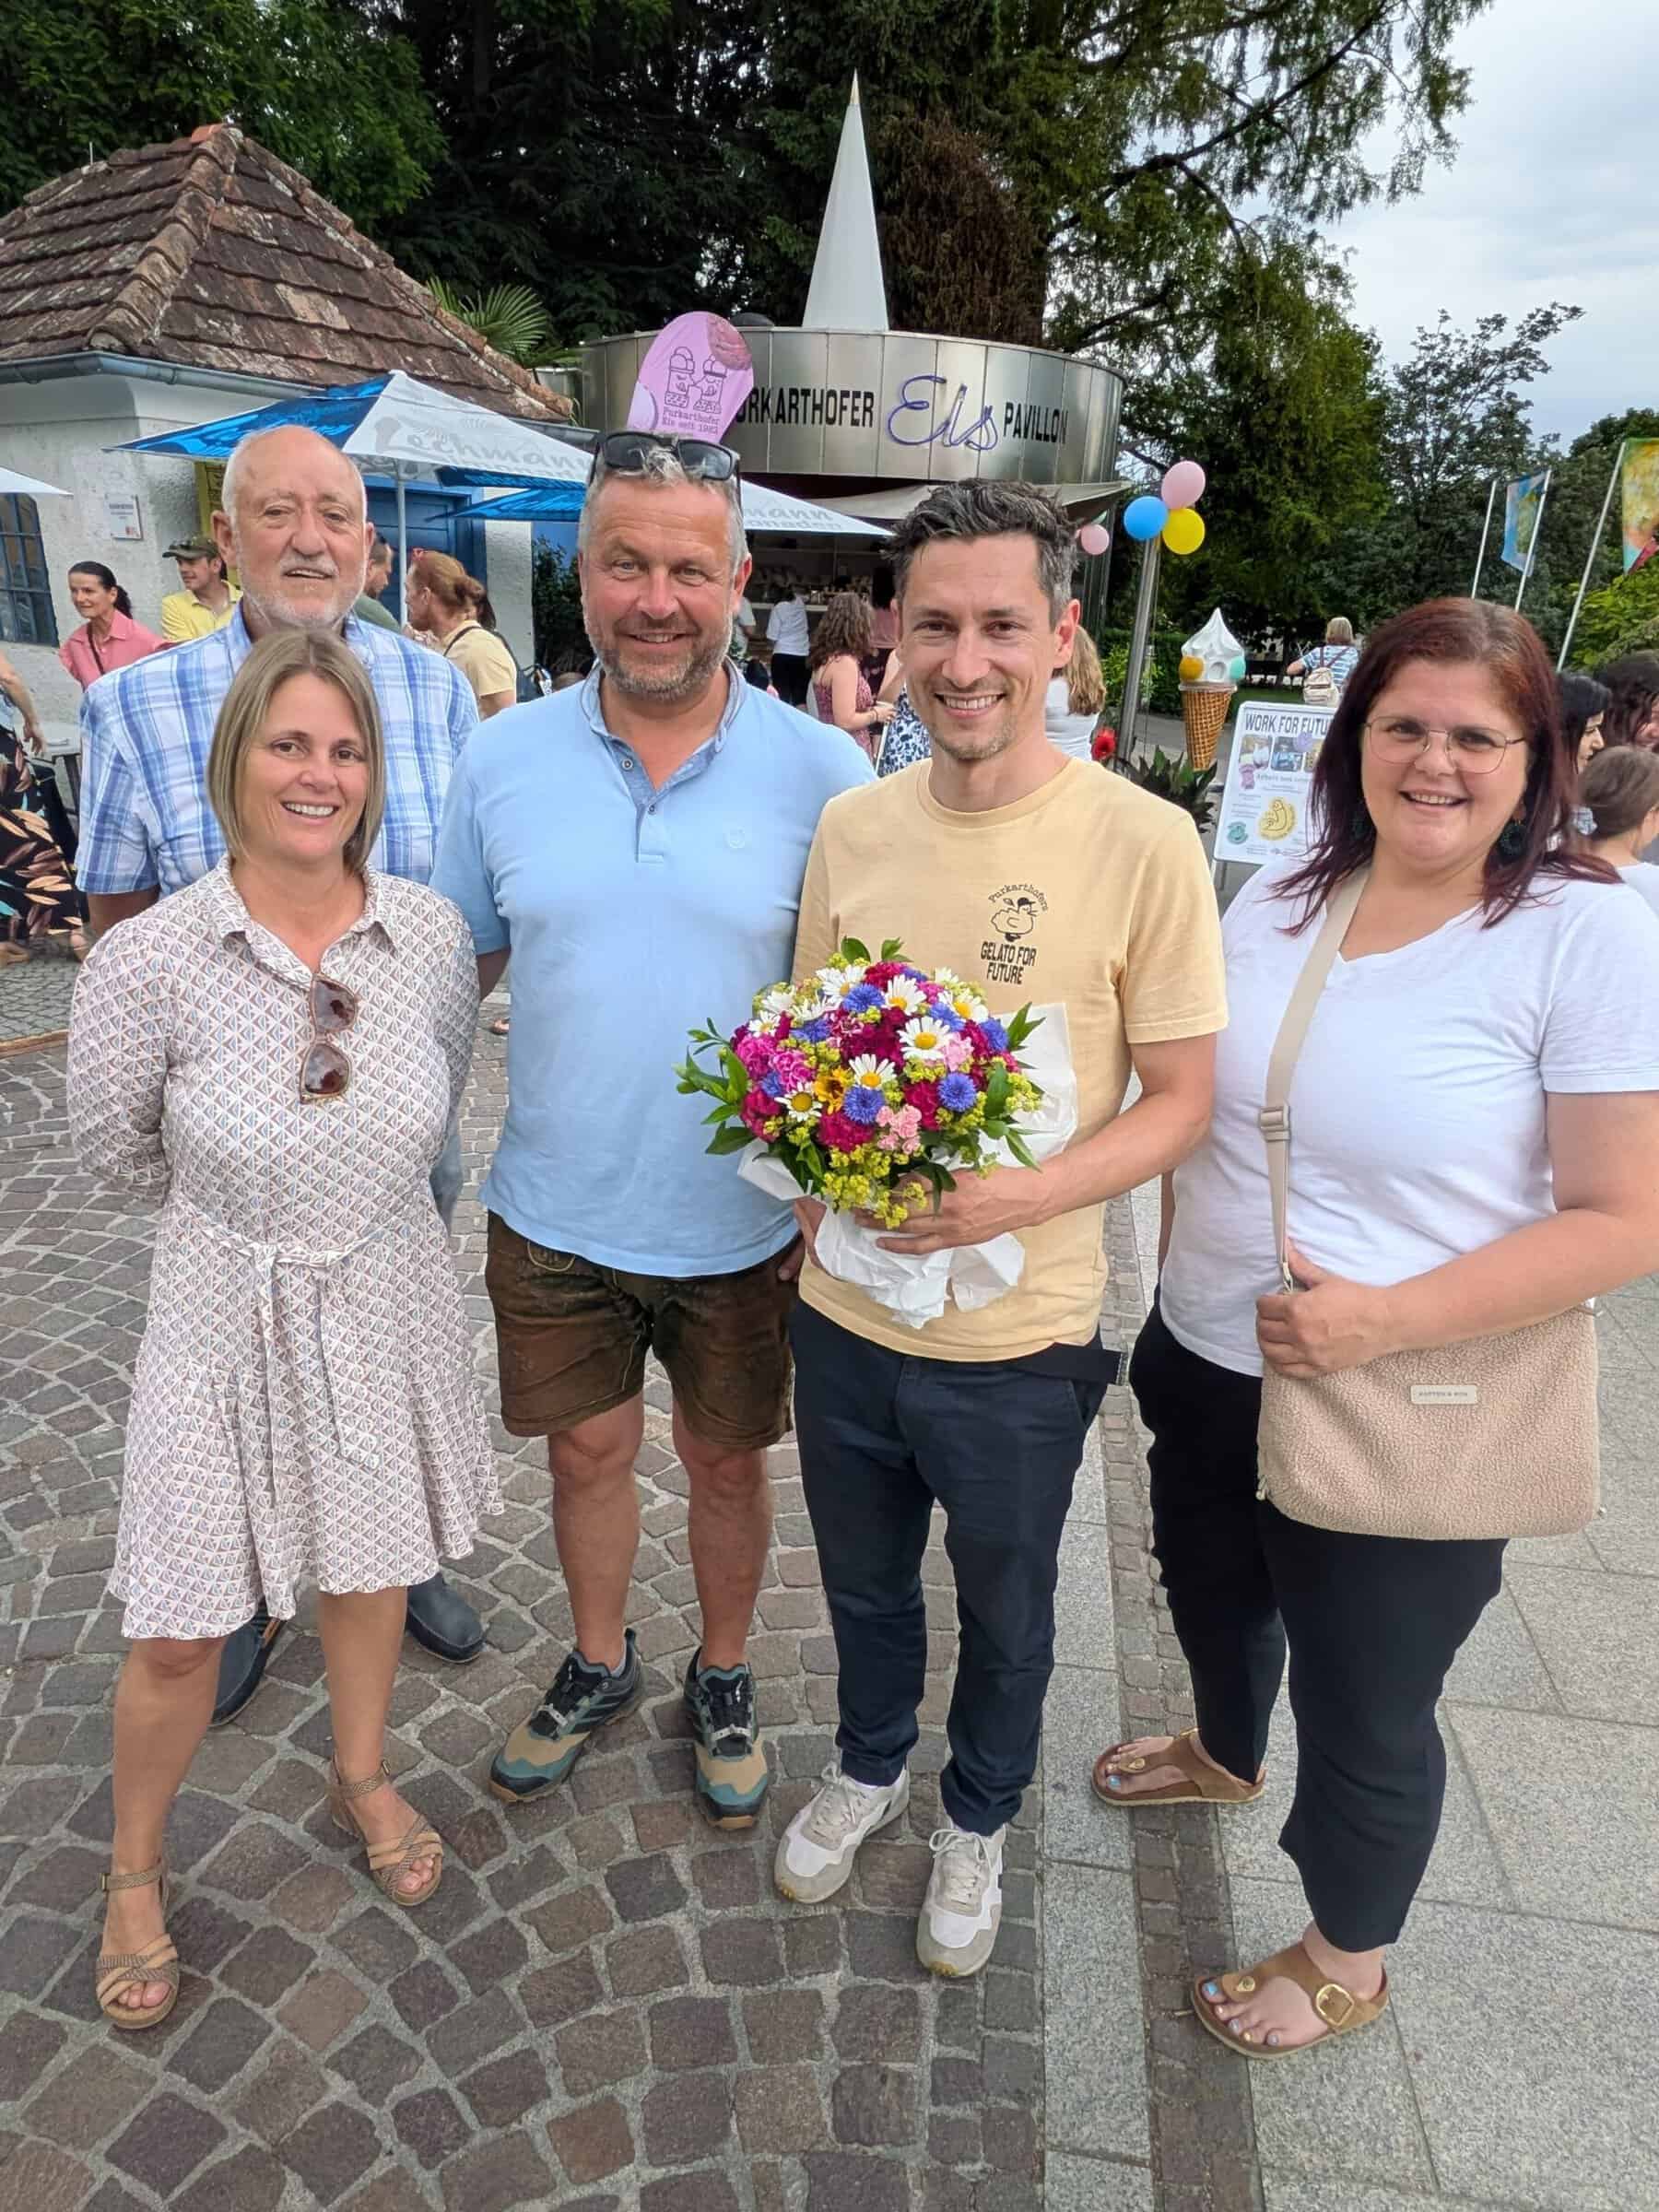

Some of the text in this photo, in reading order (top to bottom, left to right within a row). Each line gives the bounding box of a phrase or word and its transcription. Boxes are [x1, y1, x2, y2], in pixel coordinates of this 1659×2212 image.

[735, 387, 875, 427] RKARTHOFER
[1003, 402, 1069, 444] PAVILLON
[1245, 713, 1328, 735] WORK FOR FUTU
[980, 941, 1037, 967] GELATO FOR
[986, 962, 1024, 985] FUTURE
